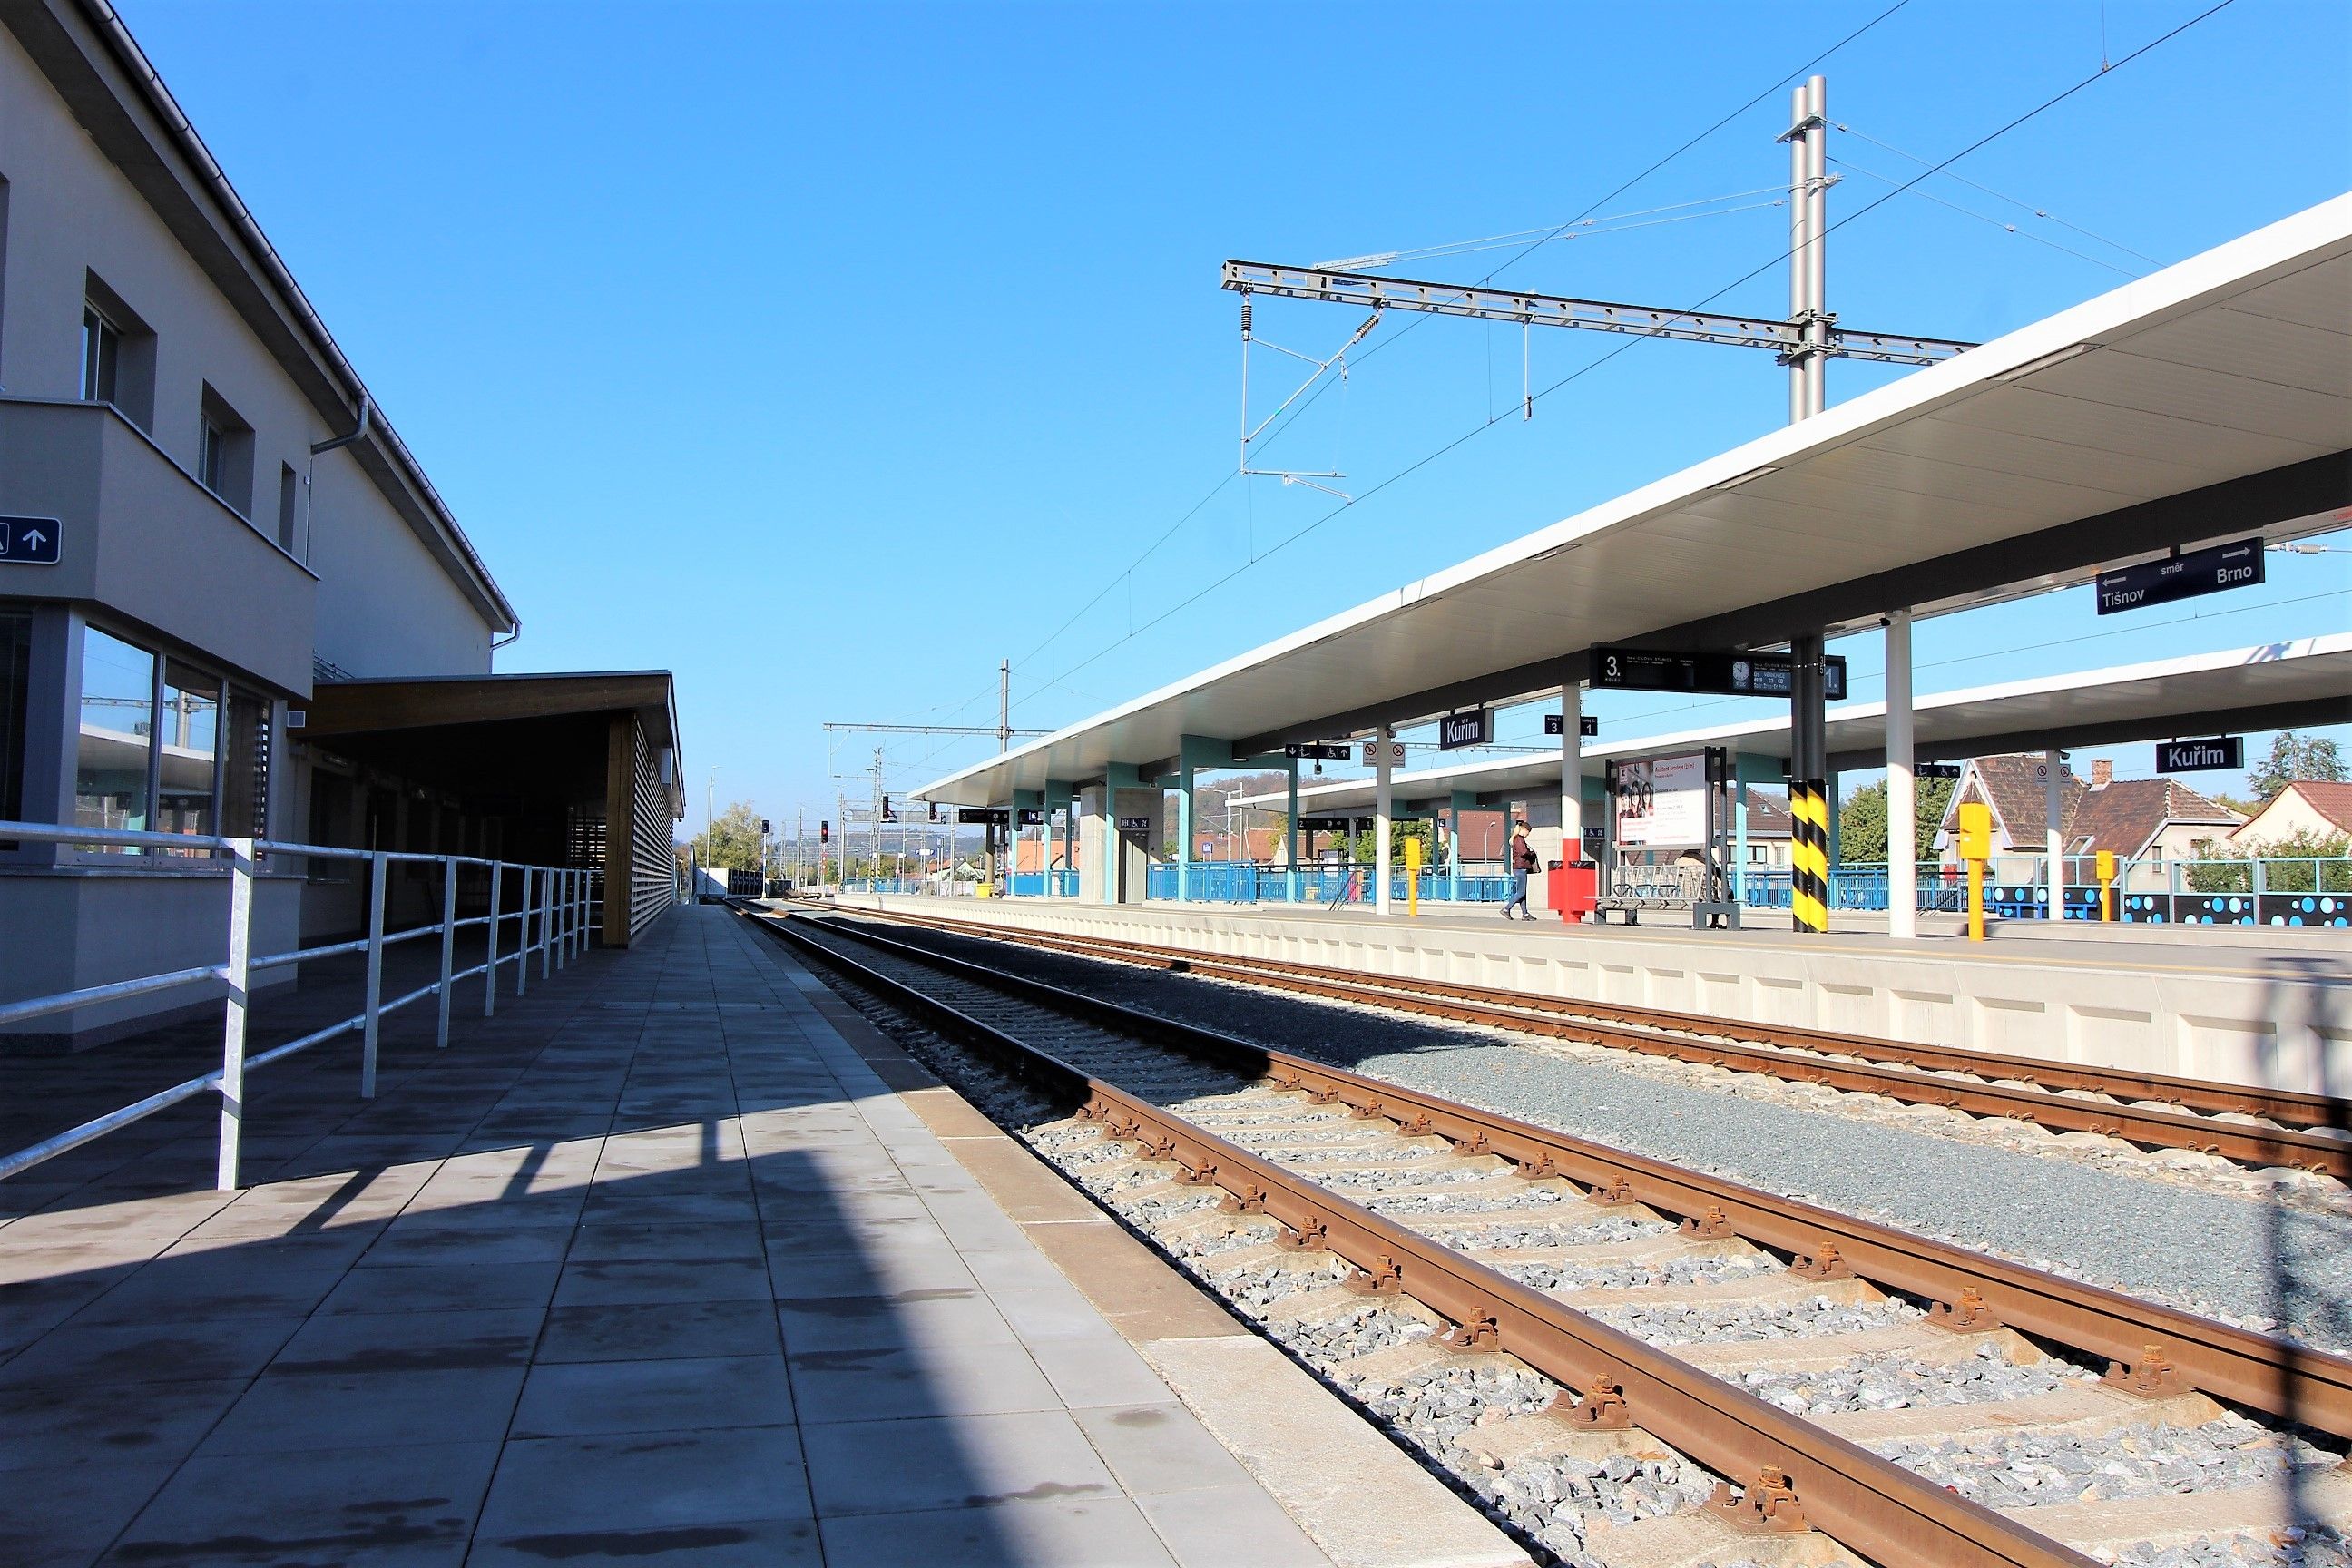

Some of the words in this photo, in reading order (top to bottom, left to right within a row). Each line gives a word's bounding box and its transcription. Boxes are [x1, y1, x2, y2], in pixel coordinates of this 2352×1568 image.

[2161, 562, 2184, 576] směr
[2217, 566, 2252, 584] Brno
[2102, 589, 2145, 608] Tišnov
[1606, 656, 1621, 677] 3.
[1447, 718, 1479, 743] Kuřim
[1551, 722, 1558, 733] 3
[1586, 724, 1592, 734] 1
[2169, 745, 2224, 768] Kuřim
